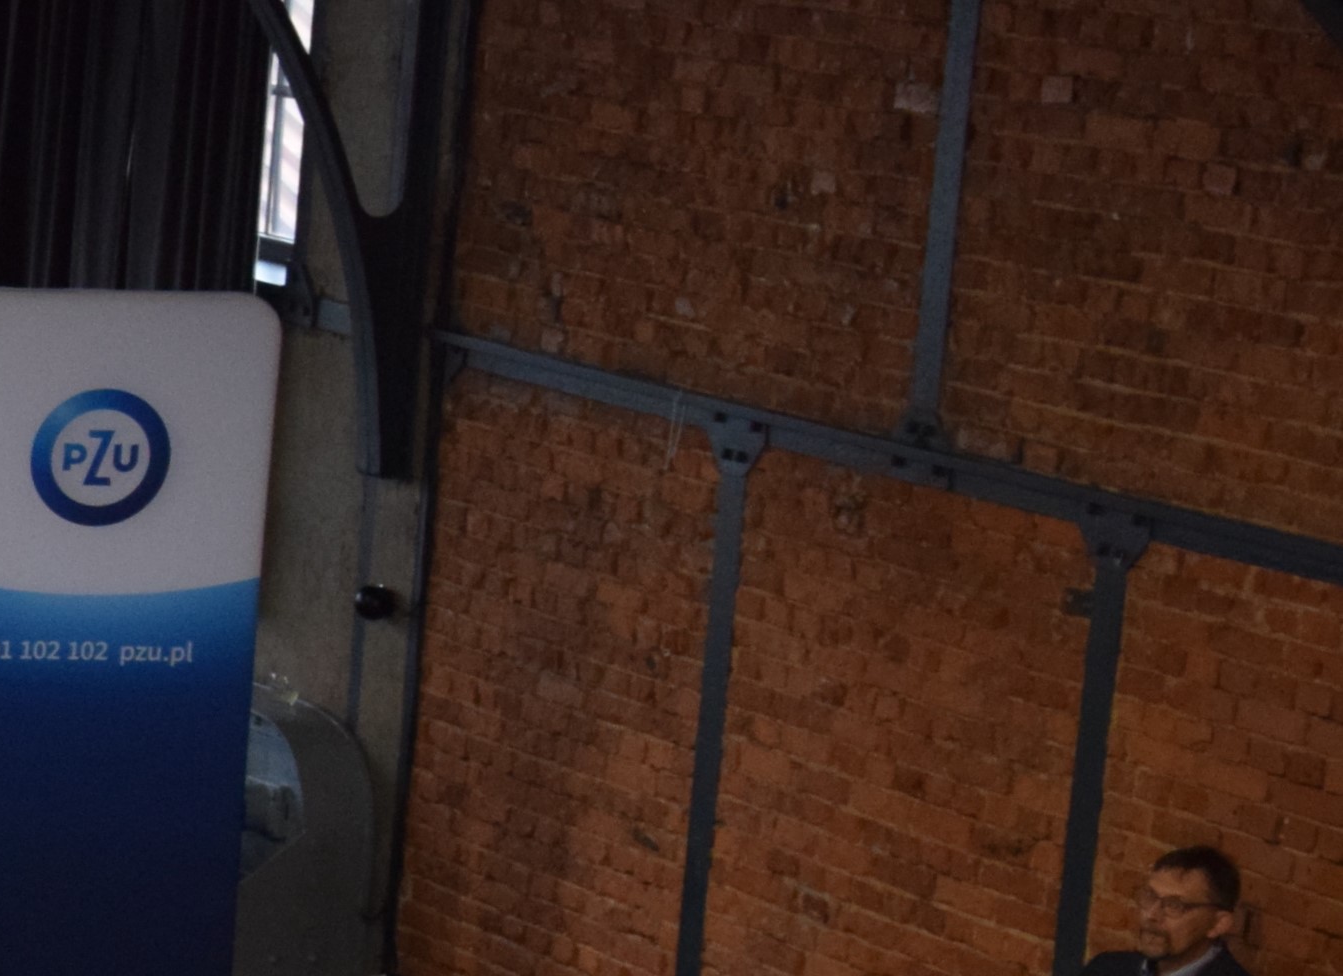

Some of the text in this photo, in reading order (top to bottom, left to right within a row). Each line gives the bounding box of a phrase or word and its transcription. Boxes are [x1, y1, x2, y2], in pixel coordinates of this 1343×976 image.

[62, 430, 139, 486] PZU
[19, 640, 60, 661] 102
[67, 640, 108, 661] 102
[119, 642, 193, 666] pzu.pl
